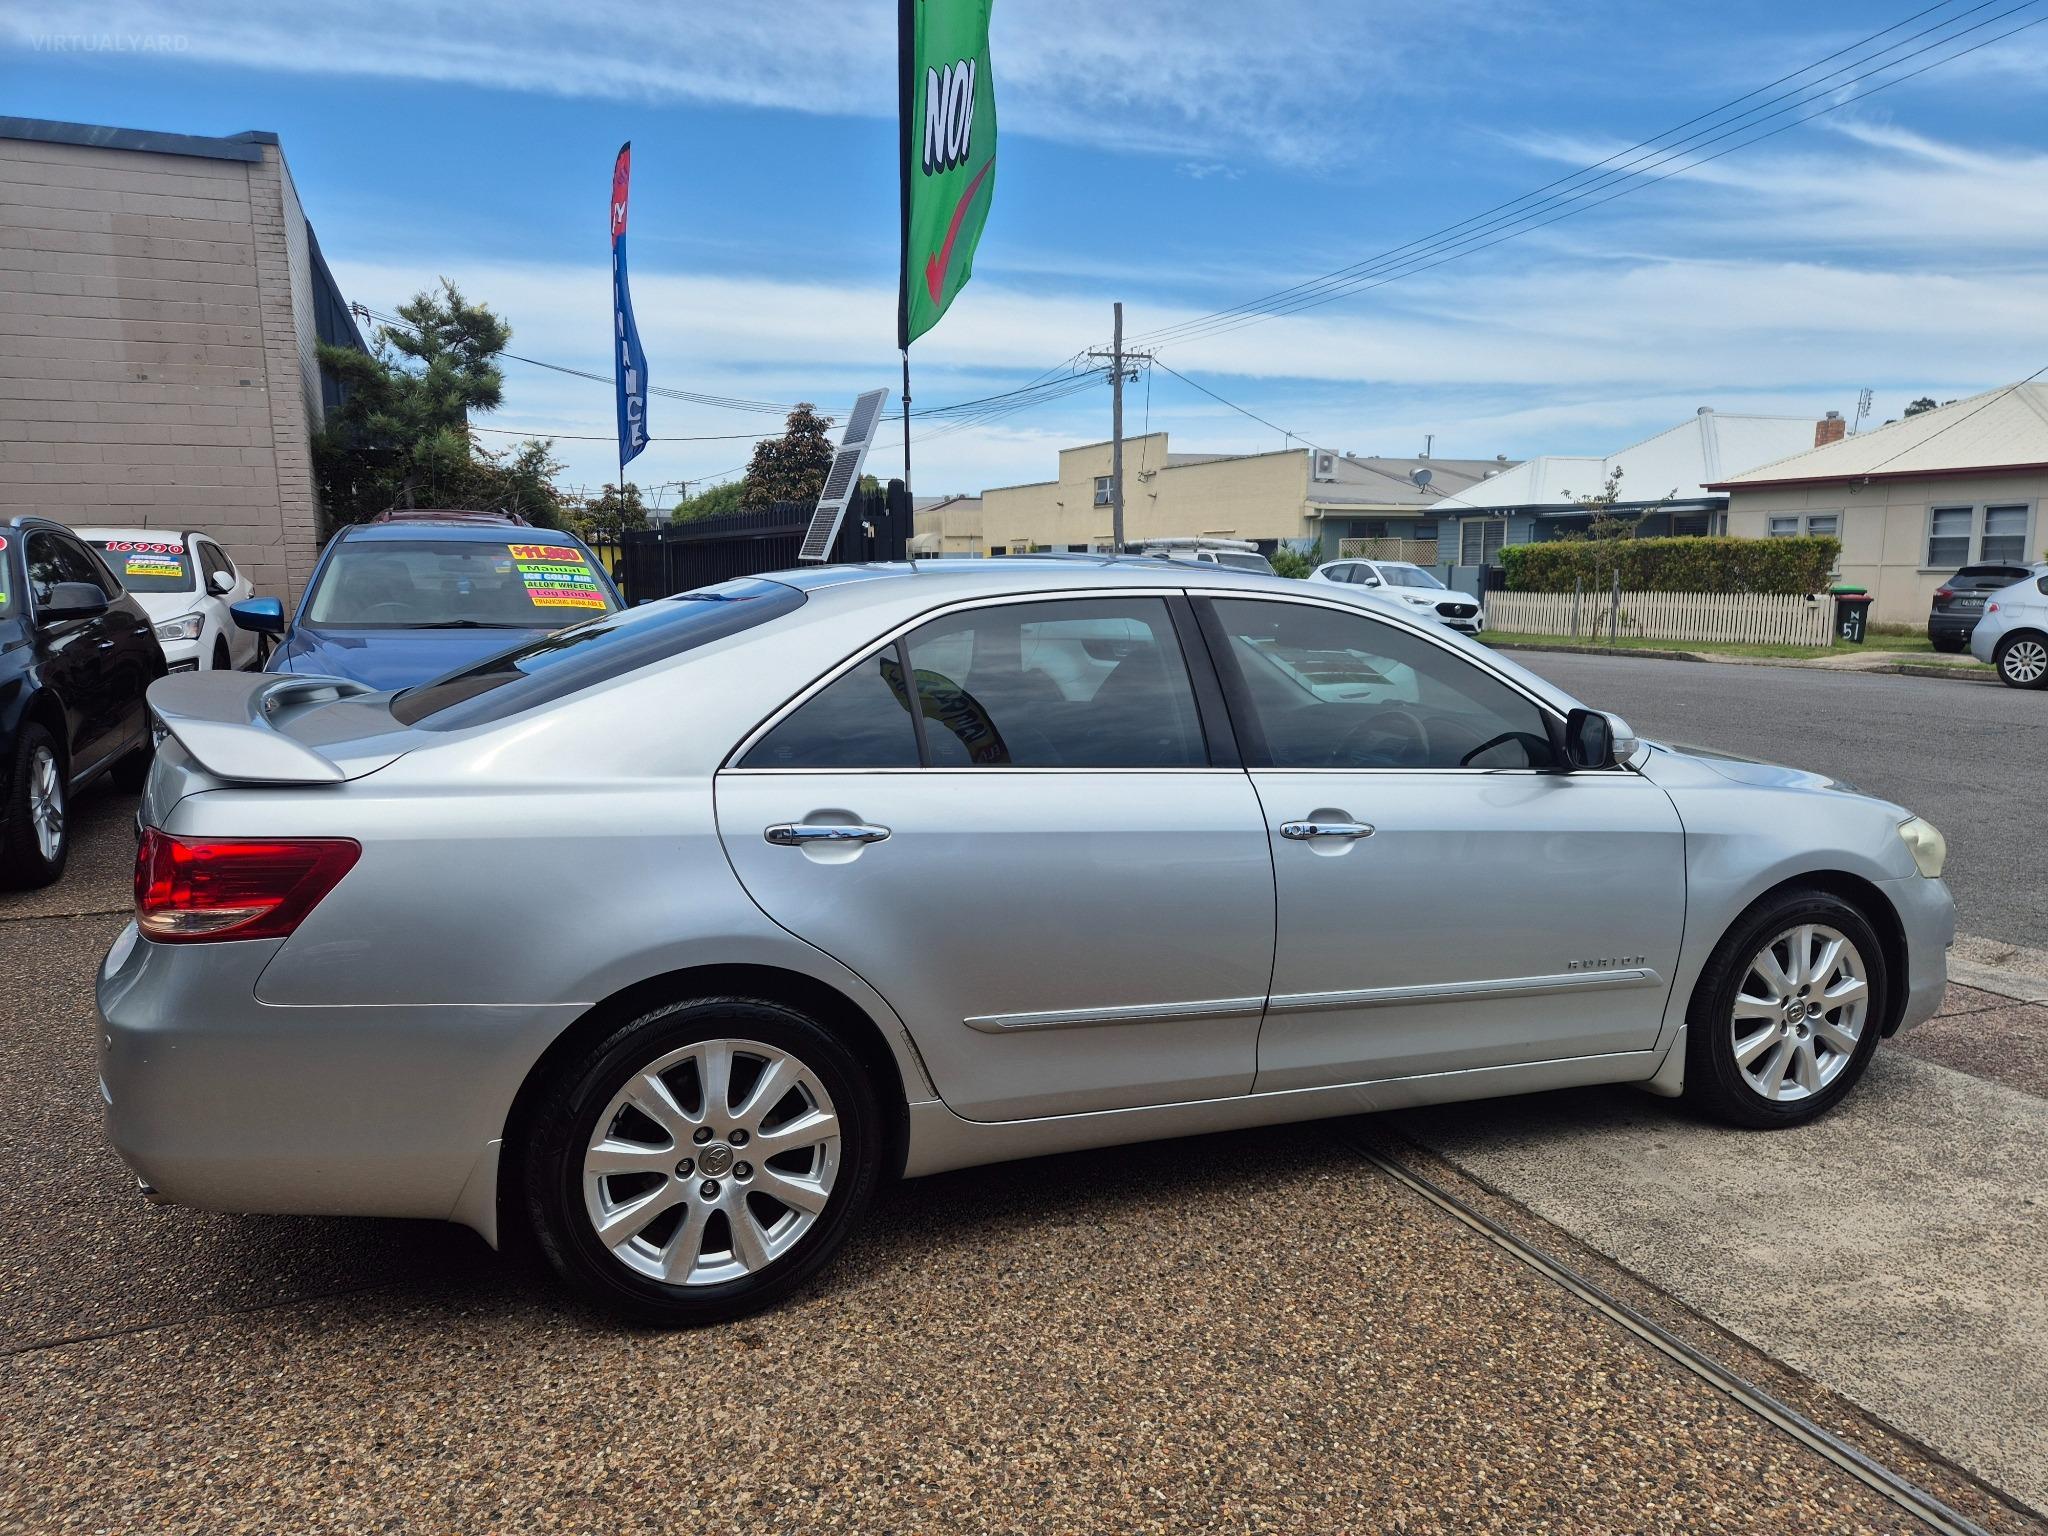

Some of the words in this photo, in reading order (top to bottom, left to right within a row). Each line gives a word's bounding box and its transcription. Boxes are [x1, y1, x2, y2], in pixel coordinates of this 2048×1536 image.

[105, 541, 184, 555] 16990
[526, 565, 581, 574] Manual
[543, 573, 572, 581] COLD
[573, 574, 593, 583] AIR
[527, 580, 555, 588] ALLOY
[558, 581, 595, 591] WHEELS
[536, 589, 558, 598] Log
[562, 590, 592, 599] Book
[1843, 622, 1859, 641] 51
